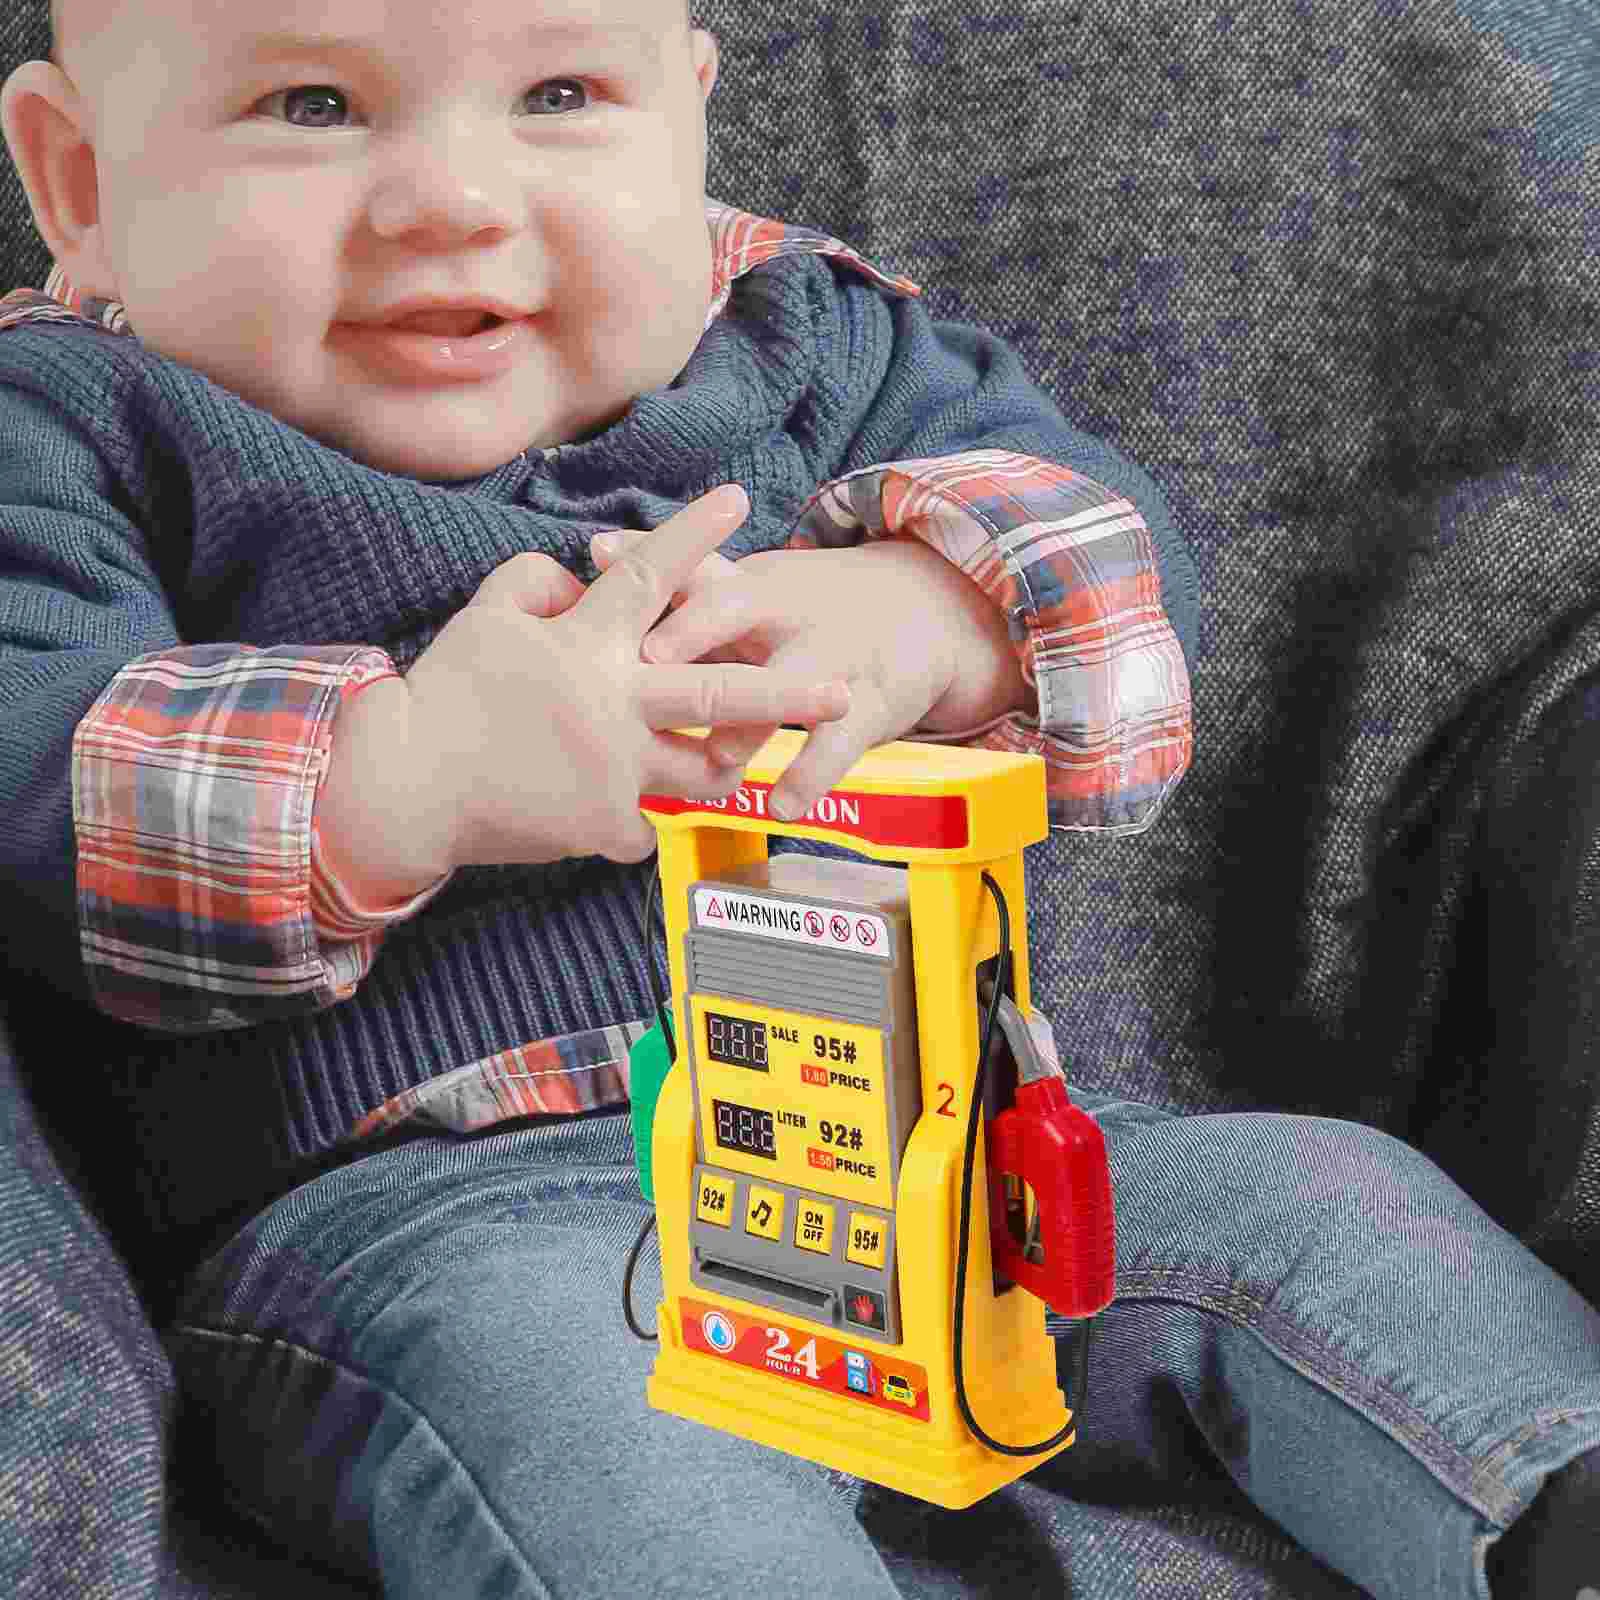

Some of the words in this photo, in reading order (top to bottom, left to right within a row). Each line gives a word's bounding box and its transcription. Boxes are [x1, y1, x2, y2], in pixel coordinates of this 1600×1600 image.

[736, 787, 860, 825] STION
[724, 899, 800, 932] WARNING
[770, 1025, 799, 1043] SALE
[813, 1034, 858, 1065] 95#
[830, 1071, 872, 1092] PRICE
[936, 1083, 956, 1118] 2
[777, 1110, 807, 1129] LITER
[819, 1120, 863, 1151] 92#
[836, 1158, 877, 1178] PRICE
[702, 1187, 725, 1211] 92#
[805, 1211, 824, 1225] ON
[803, 1229, 823, 1242] OFF
[854, 1229, 879, 1251] 95#
[765, 1327, 820, 1380] 24
